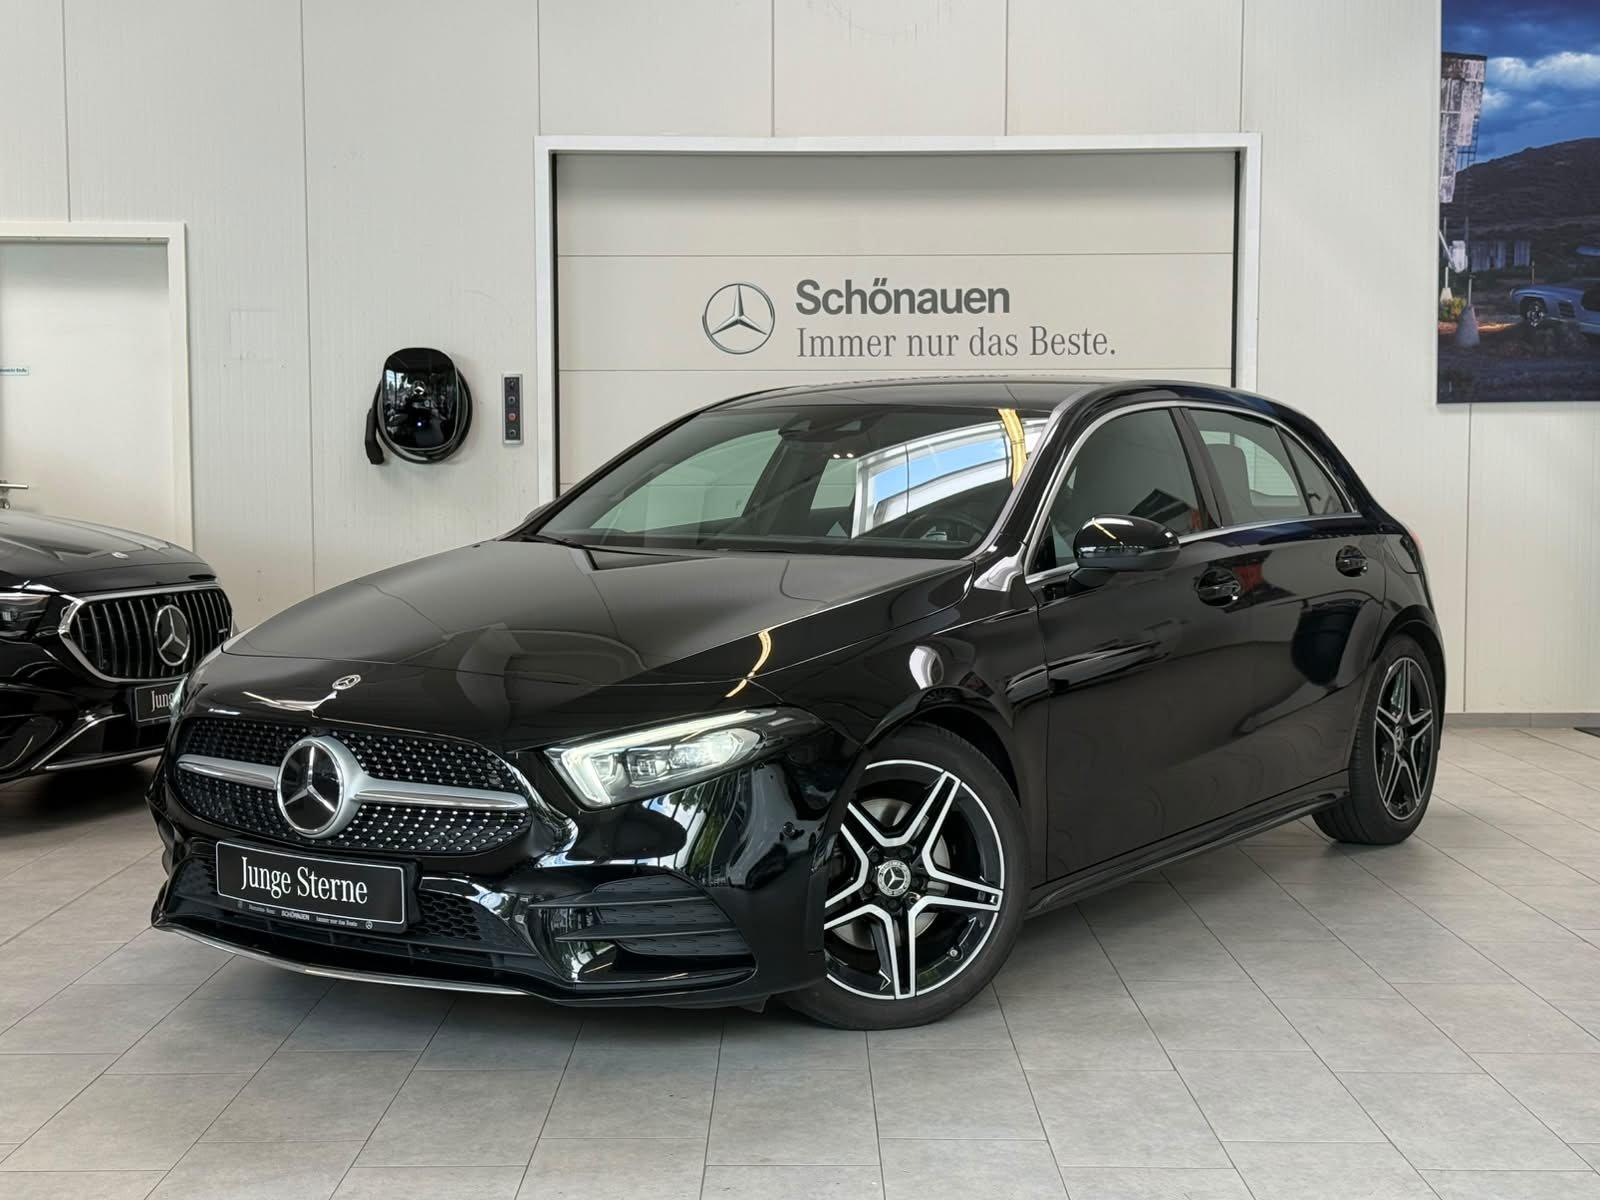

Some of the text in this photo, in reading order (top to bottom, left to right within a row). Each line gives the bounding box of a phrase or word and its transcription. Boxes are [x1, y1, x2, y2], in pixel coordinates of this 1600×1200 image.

[795, 277, 1010, 315] Schönauen
[796, 325, 1116, 358] Immer nur das Beste.
[241, 856, 368, 904] Junge Sterne
